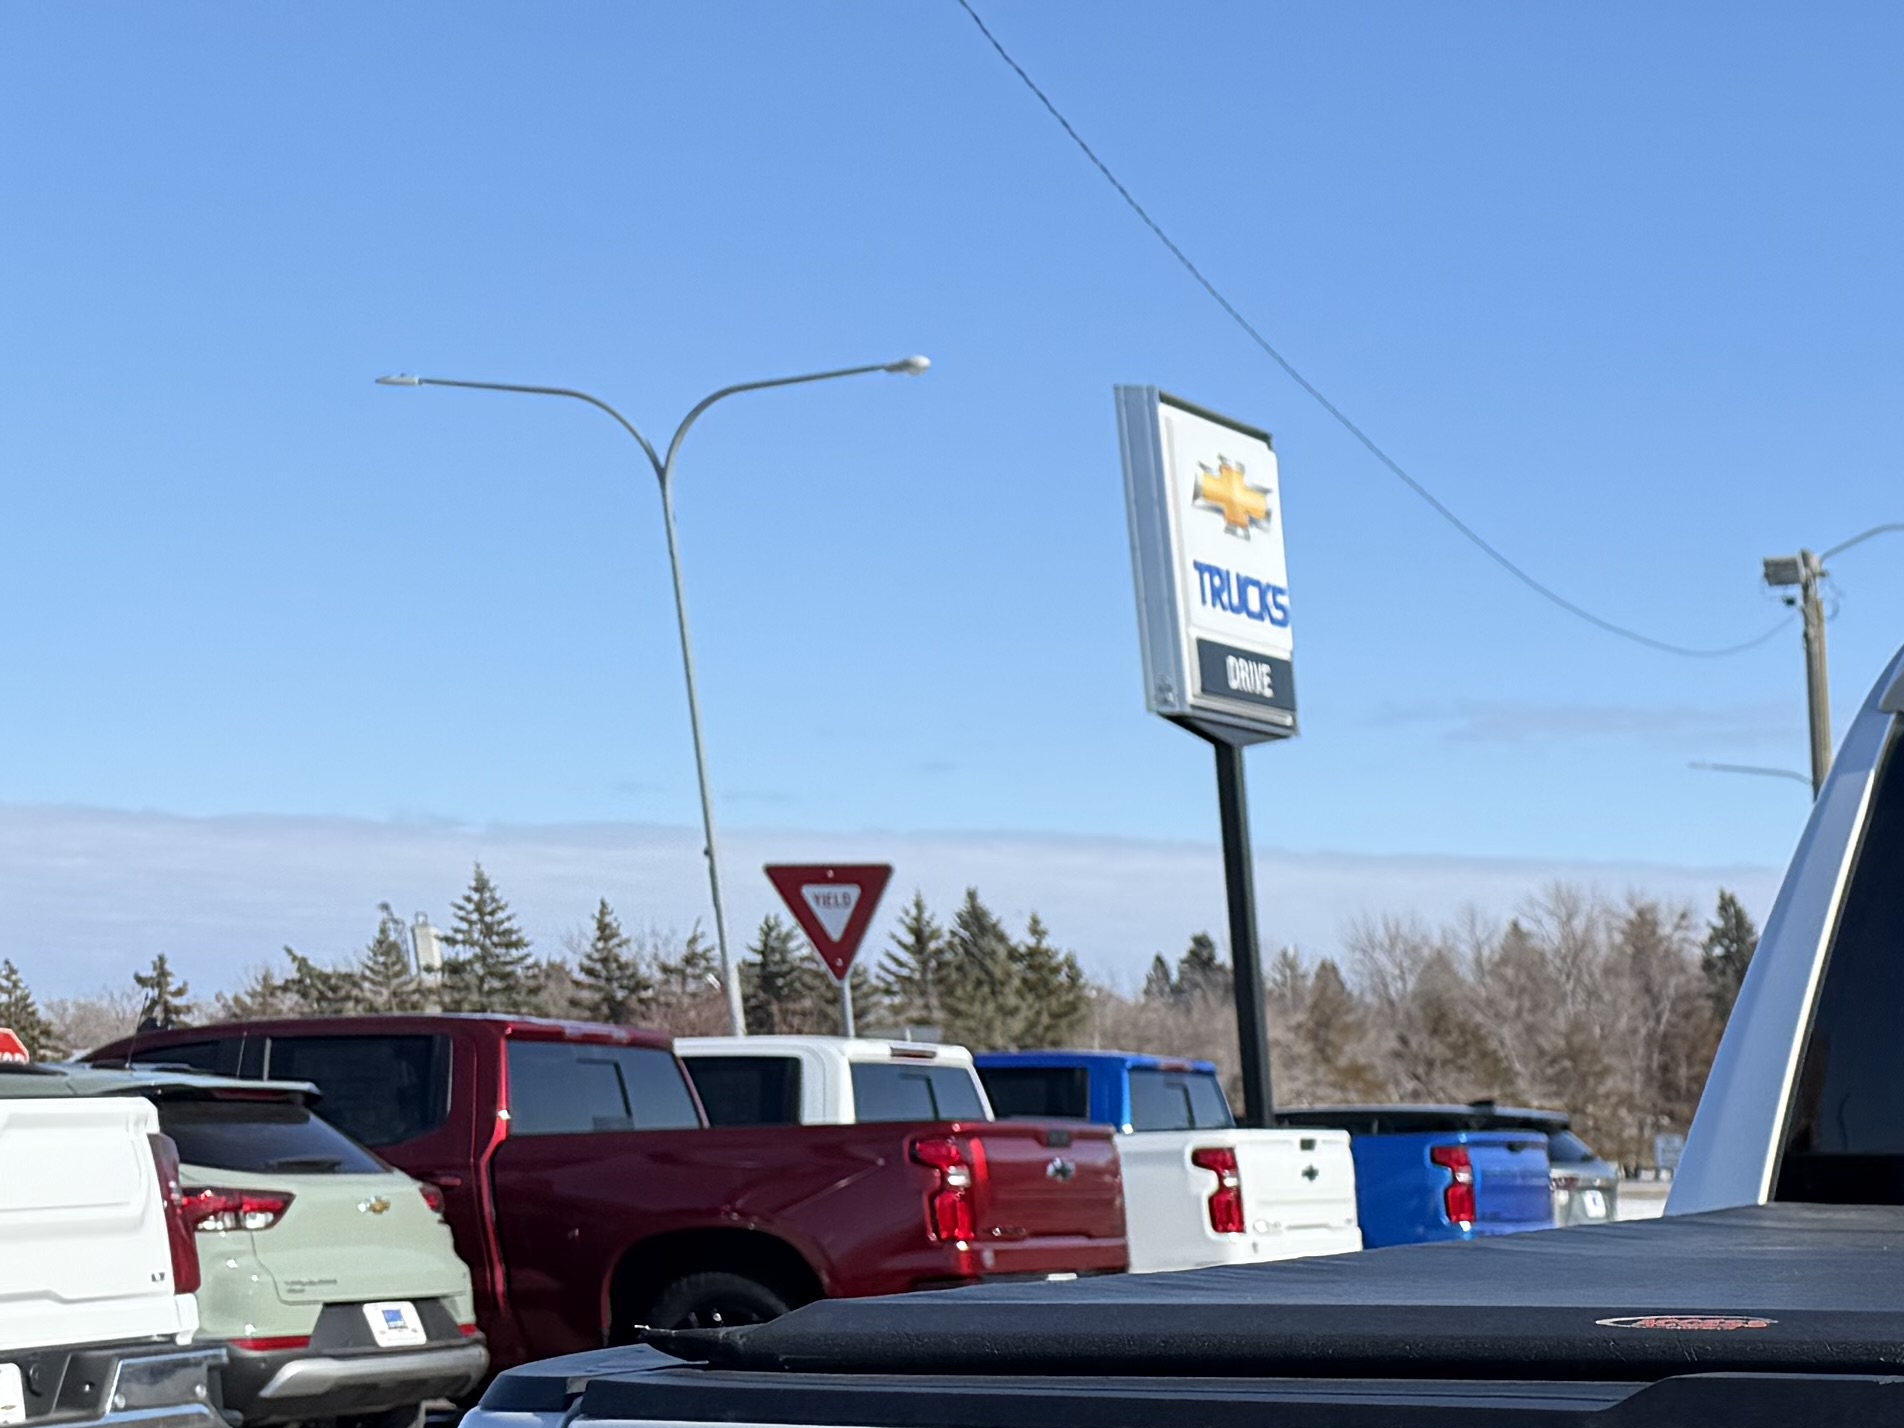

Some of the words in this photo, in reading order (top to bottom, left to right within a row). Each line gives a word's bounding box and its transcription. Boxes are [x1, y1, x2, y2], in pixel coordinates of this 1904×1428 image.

[1193, 559, 1290, 628] TRUCKS
[1226, 654, 1274, 698] DRIVE
[813, 891, 852, 909] YIELD
